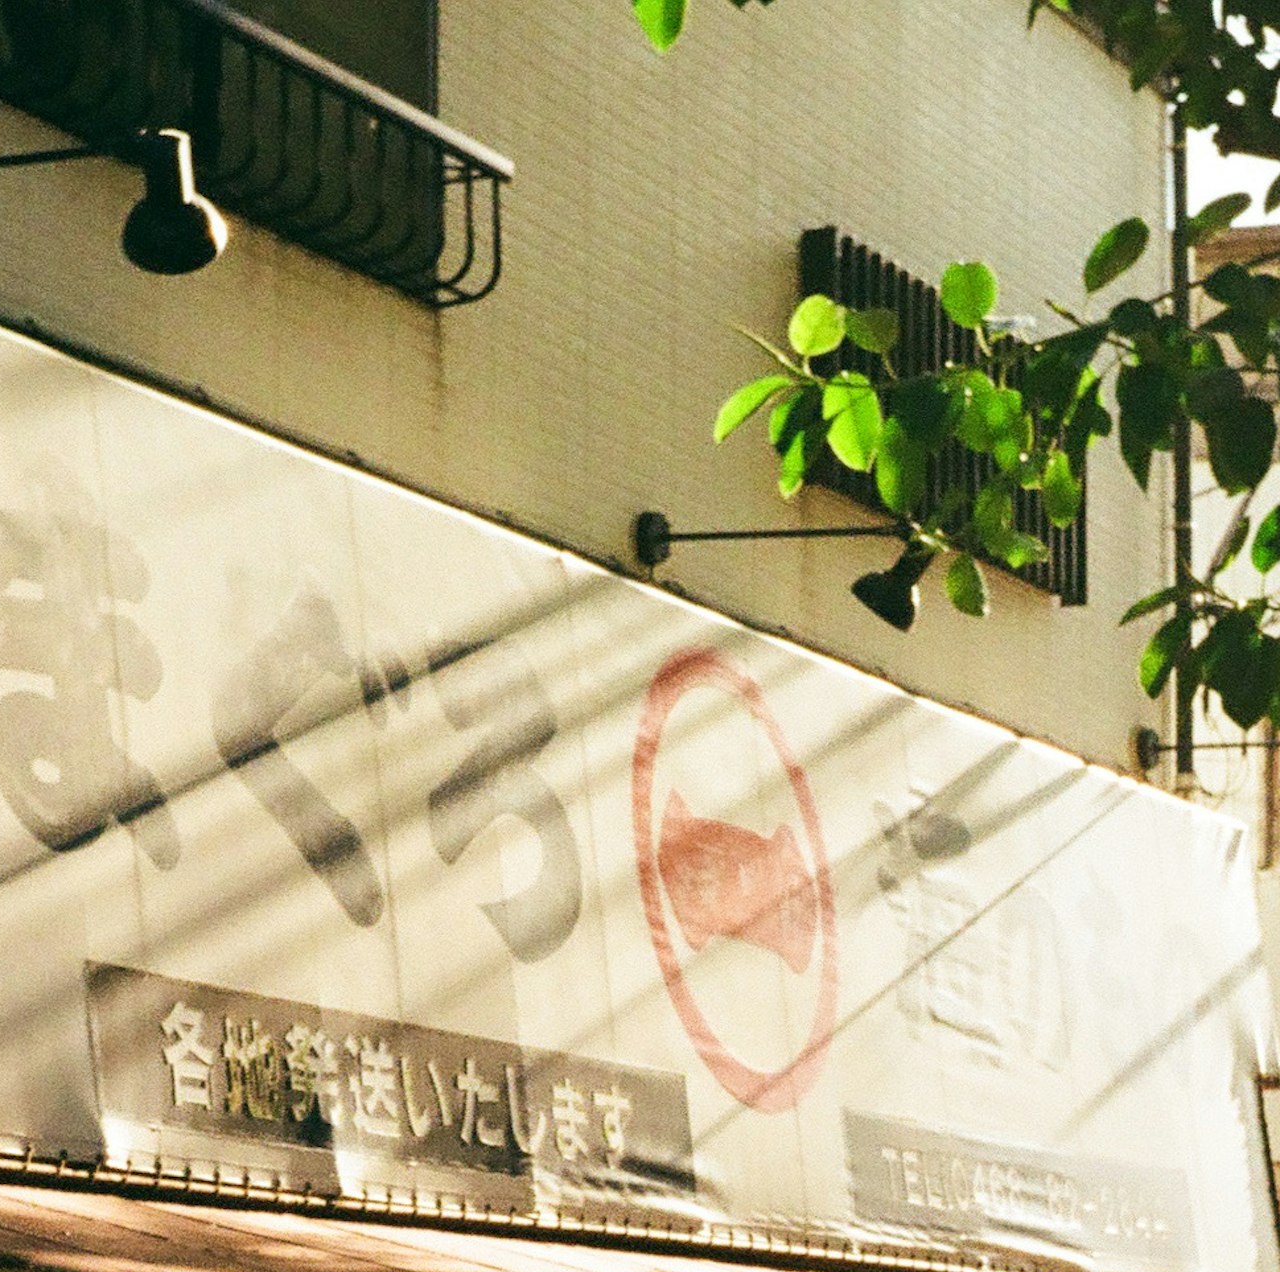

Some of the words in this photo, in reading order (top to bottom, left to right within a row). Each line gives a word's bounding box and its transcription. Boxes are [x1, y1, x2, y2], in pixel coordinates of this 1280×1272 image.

[160, 1001, 634, 1169] 各地発送いたします
